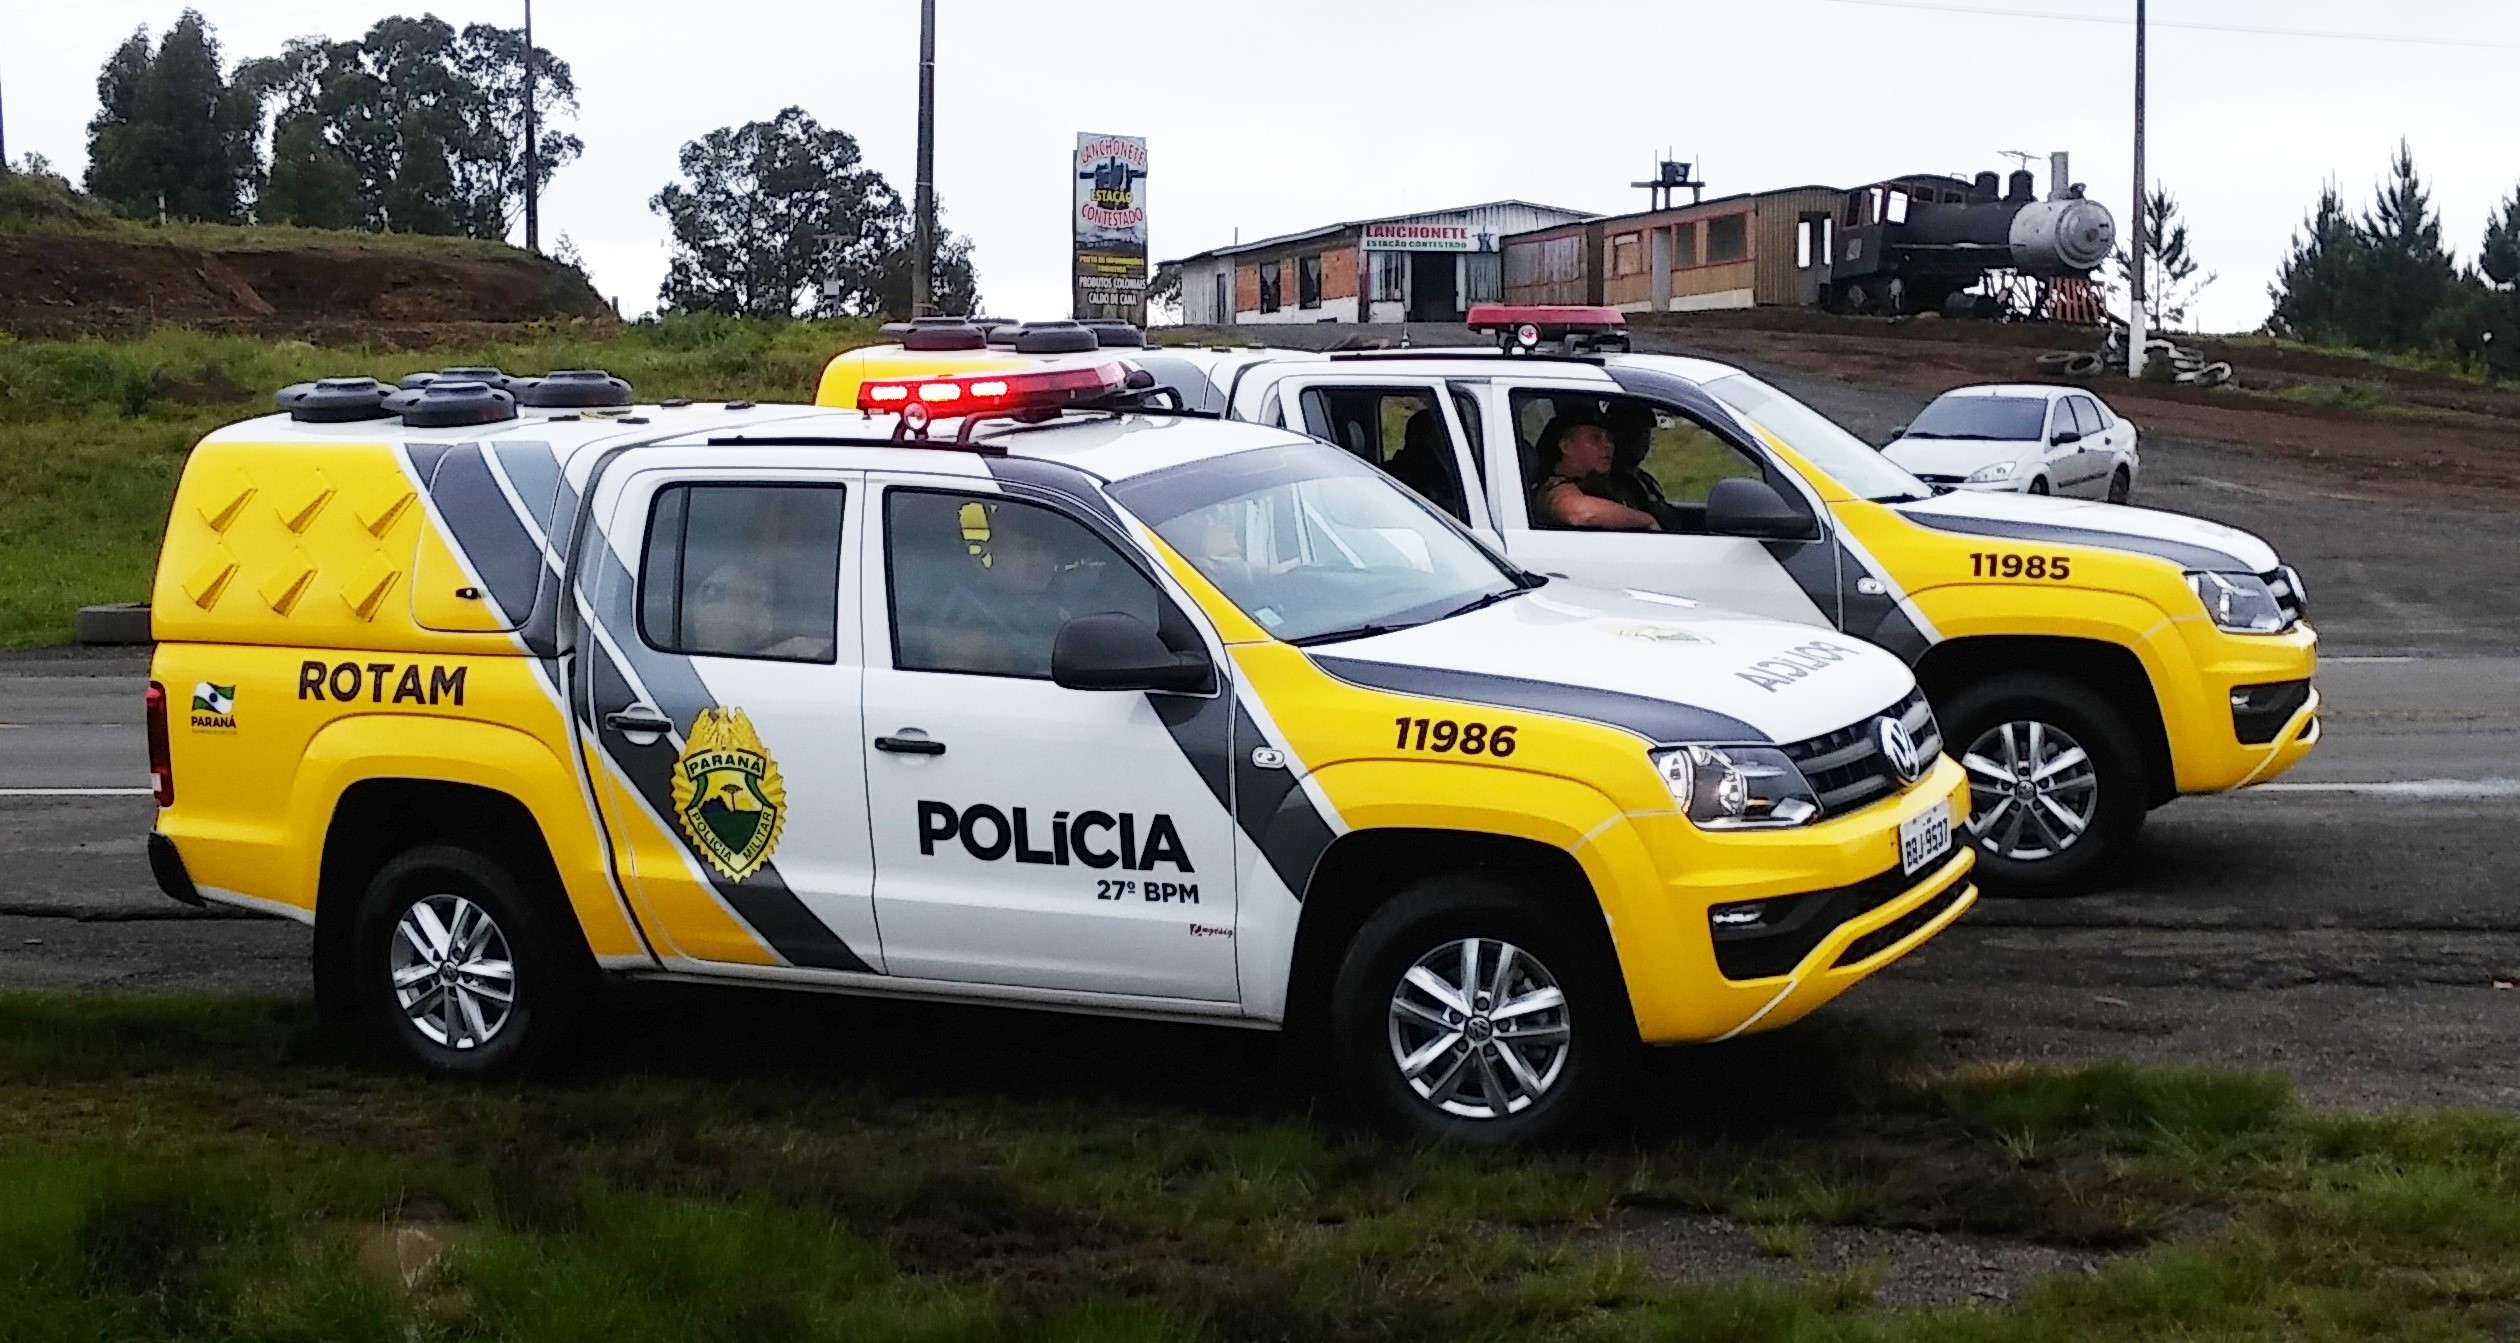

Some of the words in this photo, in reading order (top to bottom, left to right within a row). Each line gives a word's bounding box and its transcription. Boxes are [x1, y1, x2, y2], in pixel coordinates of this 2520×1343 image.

[1081, 138, 1145, 165] LANCHONETE
[1082, 203, 1143, 227] CONTESTADO
[1366, 225, 1468, 239] LANCHONETE
[1409, 241, 1467, 249] CONTESTADO
[1079, 276, 1112, 289] PRODUTOS
[1088, 292, 1109, 304] CALDO
[1970, 552, 2070, 580] 11985
[298, 660, 468, 706] ROTAM
[191, 715, 237, 729] PARANÁ
[1395, 716, 1518, 757] 11986
[688, 754, 761, 775] PARANÁ
[743, 811, 773, 862] MILITAR
[1144, 882, 1200, 904] BPM
